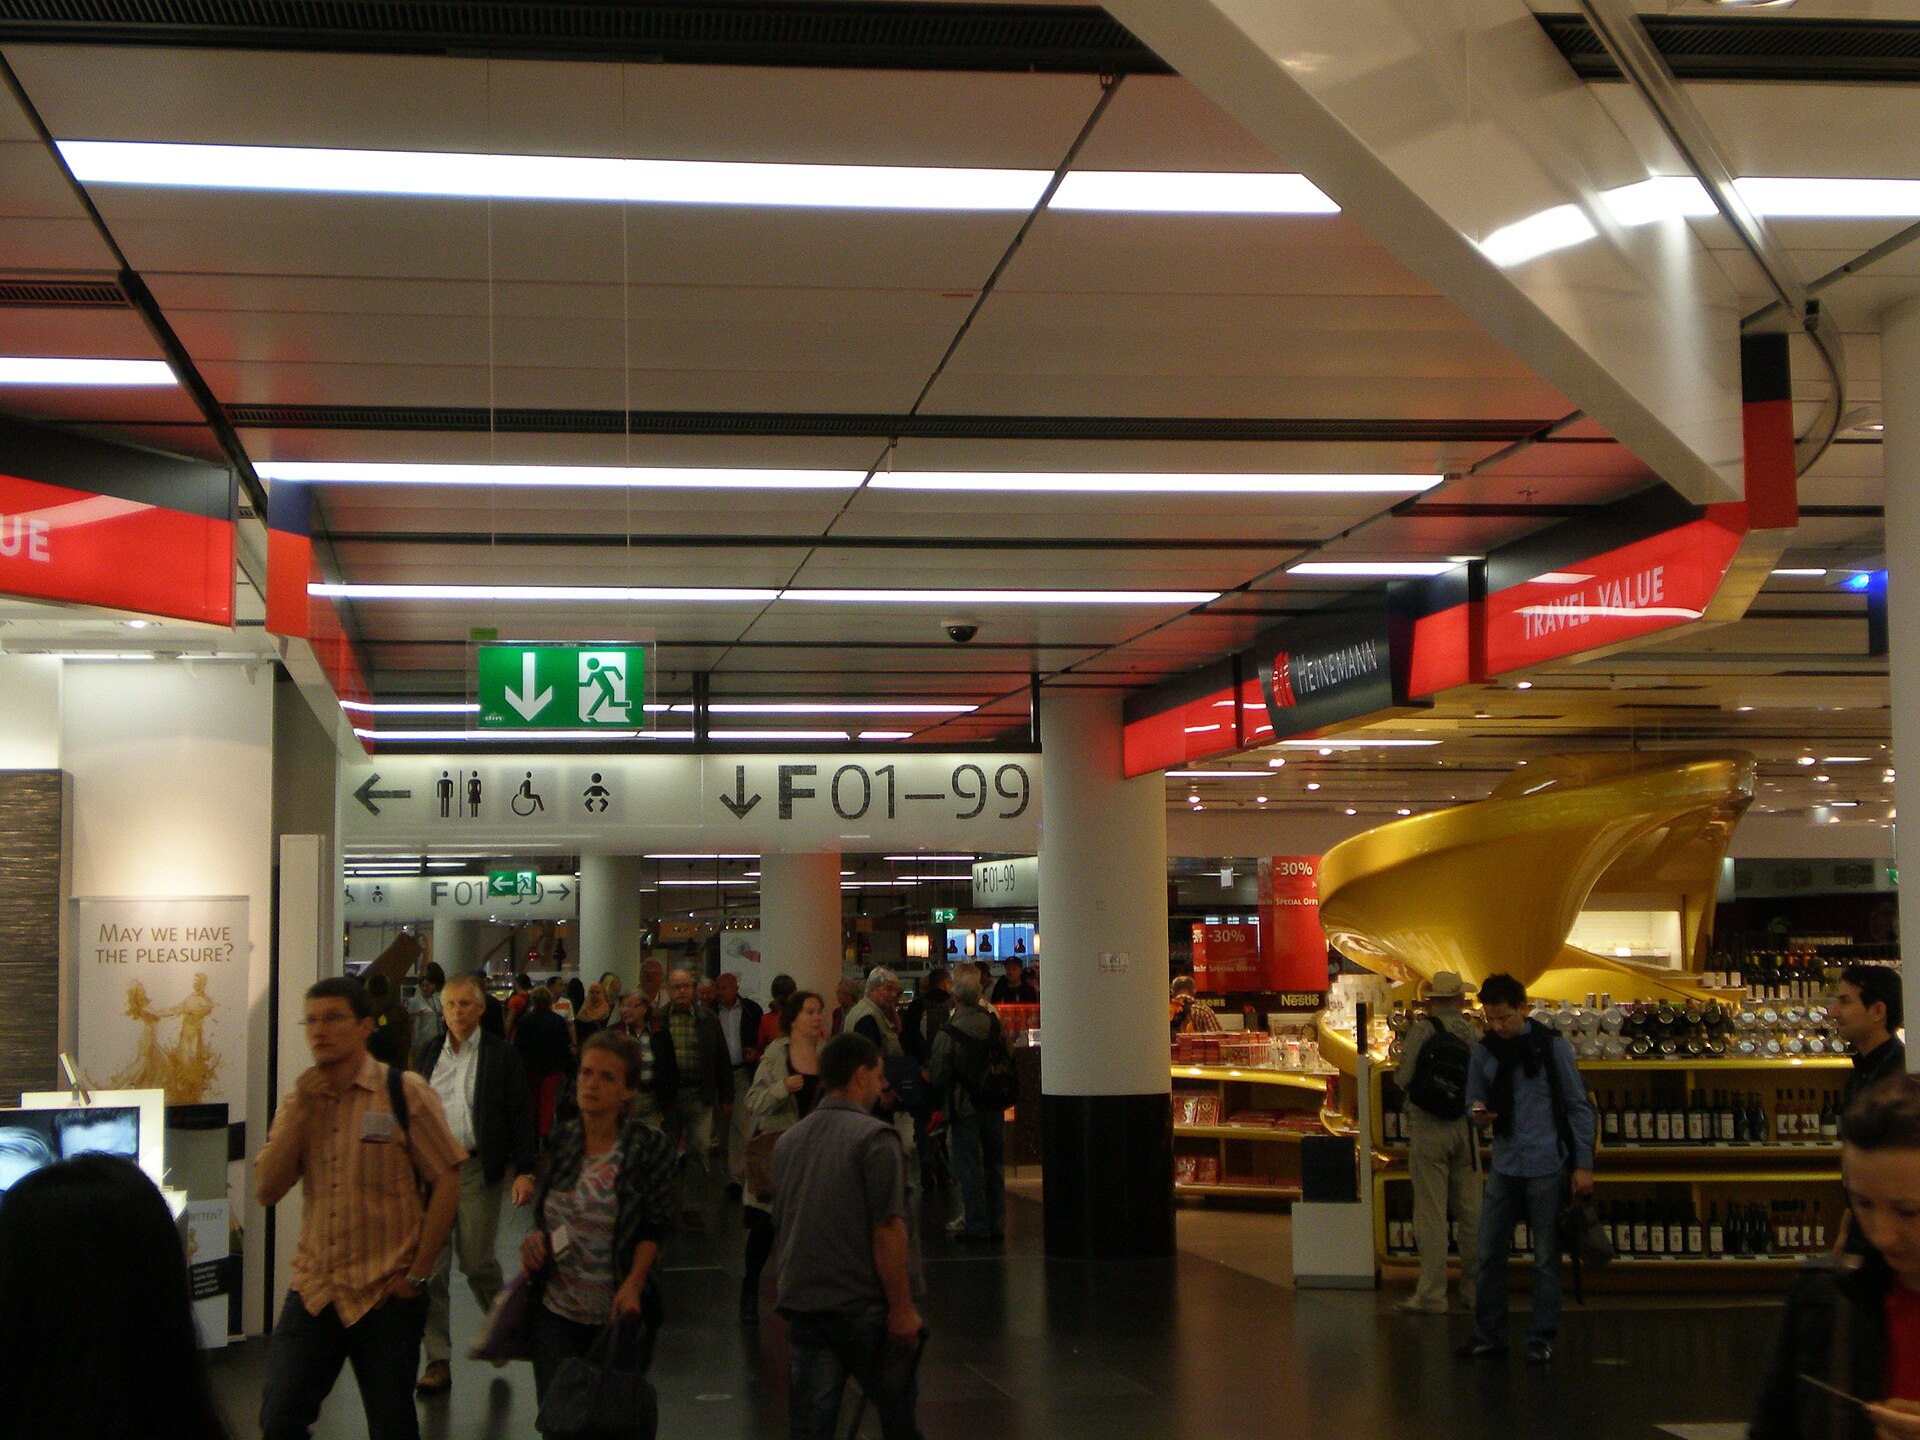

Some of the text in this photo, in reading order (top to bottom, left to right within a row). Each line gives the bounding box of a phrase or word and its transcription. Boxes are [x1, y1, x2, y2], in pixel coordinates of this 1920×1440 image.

[1523, 566, 1664, 640] TRAVEL VALUE
[1296, 638, 1378, 694] HEINEMANN
[1275, 862, 1313, 876] -30%
[430, 880, 544, 906] F01
[99, 923, 231, 943] MAY WE HAVE
[1208, 930, 1246, 943] -30%
[95, 942, 234, 964] THE PLEASURE?
